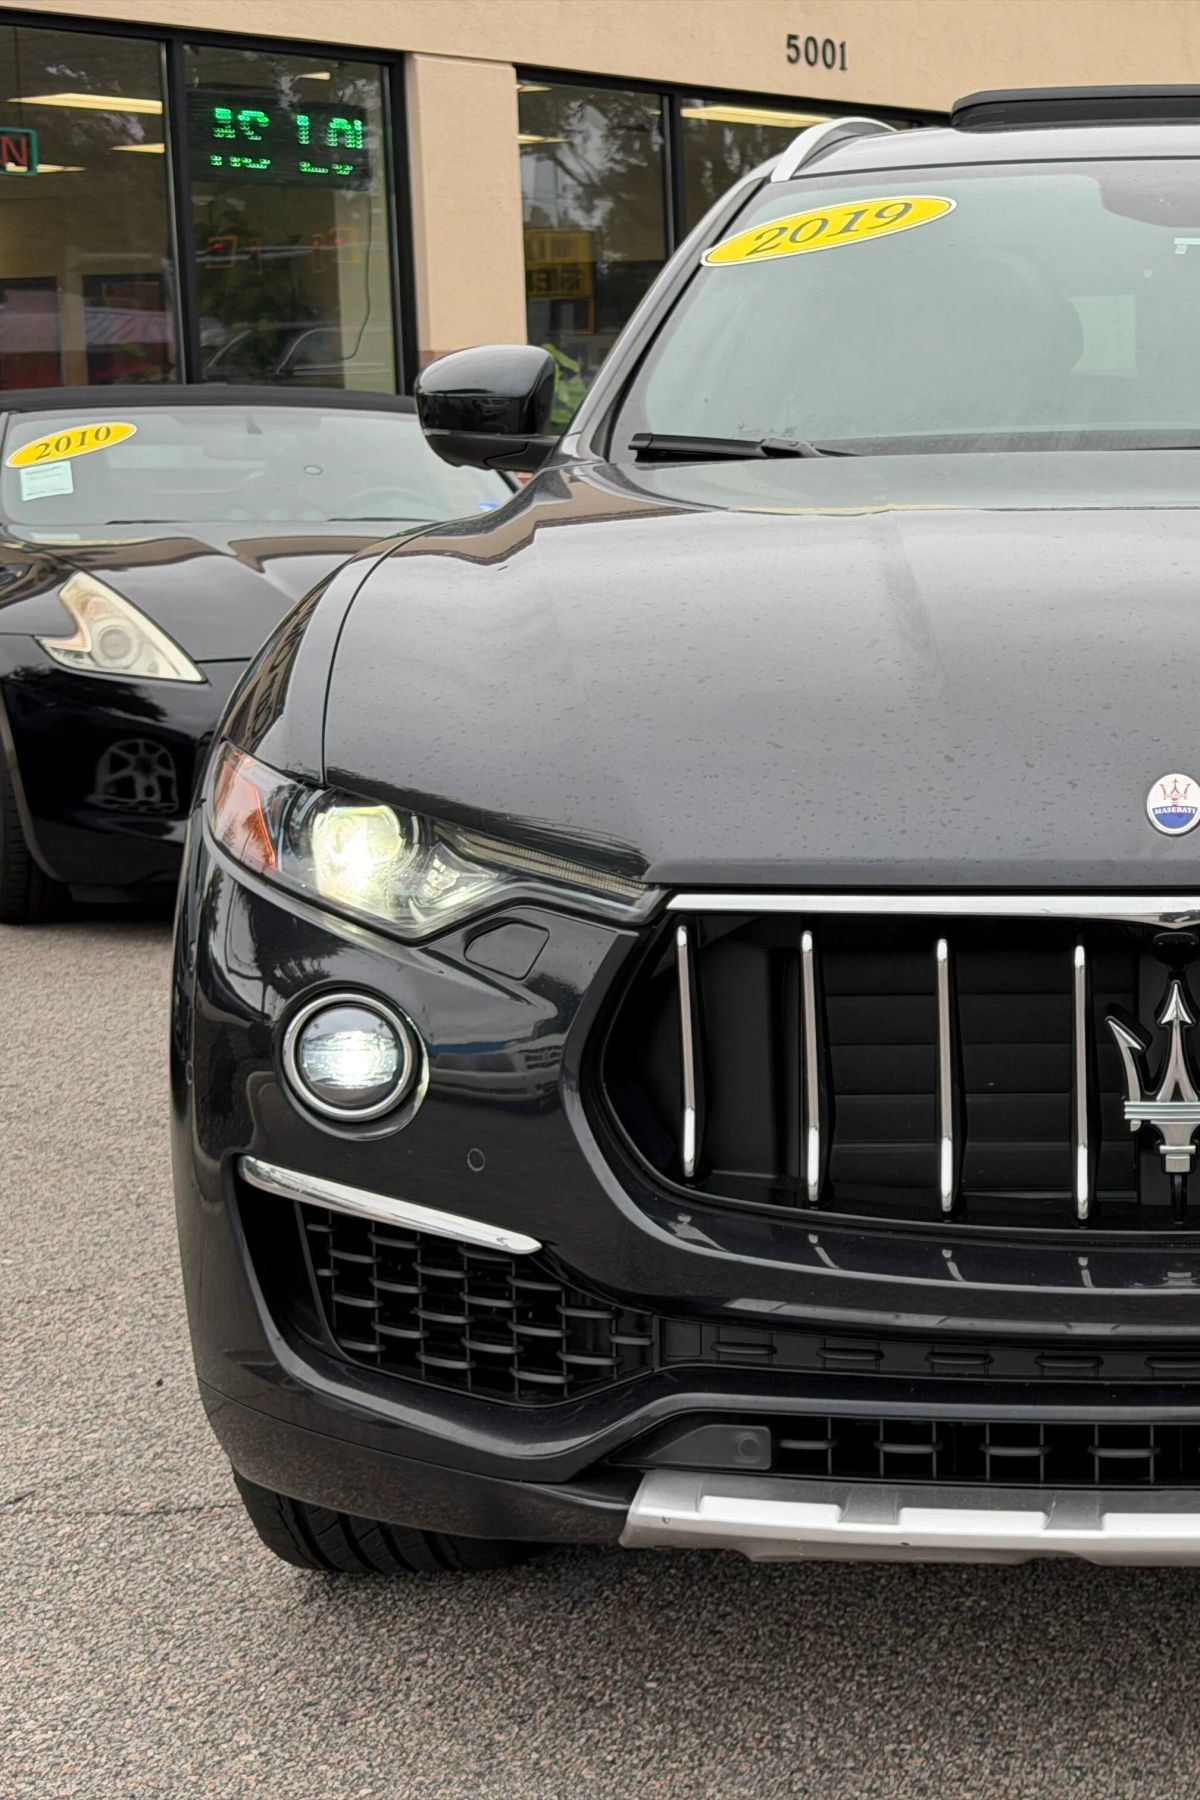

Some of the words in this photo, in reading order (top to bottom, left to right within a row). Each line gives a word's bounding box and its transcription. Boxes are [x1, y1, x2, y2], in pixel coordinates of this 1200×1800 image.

[786, 33, 847, 71] 5001
[745, 202, 913, 256] 2019
[35, 426, 111, 460] 2010
[1154, 806, 1196, 815] MASERATI
